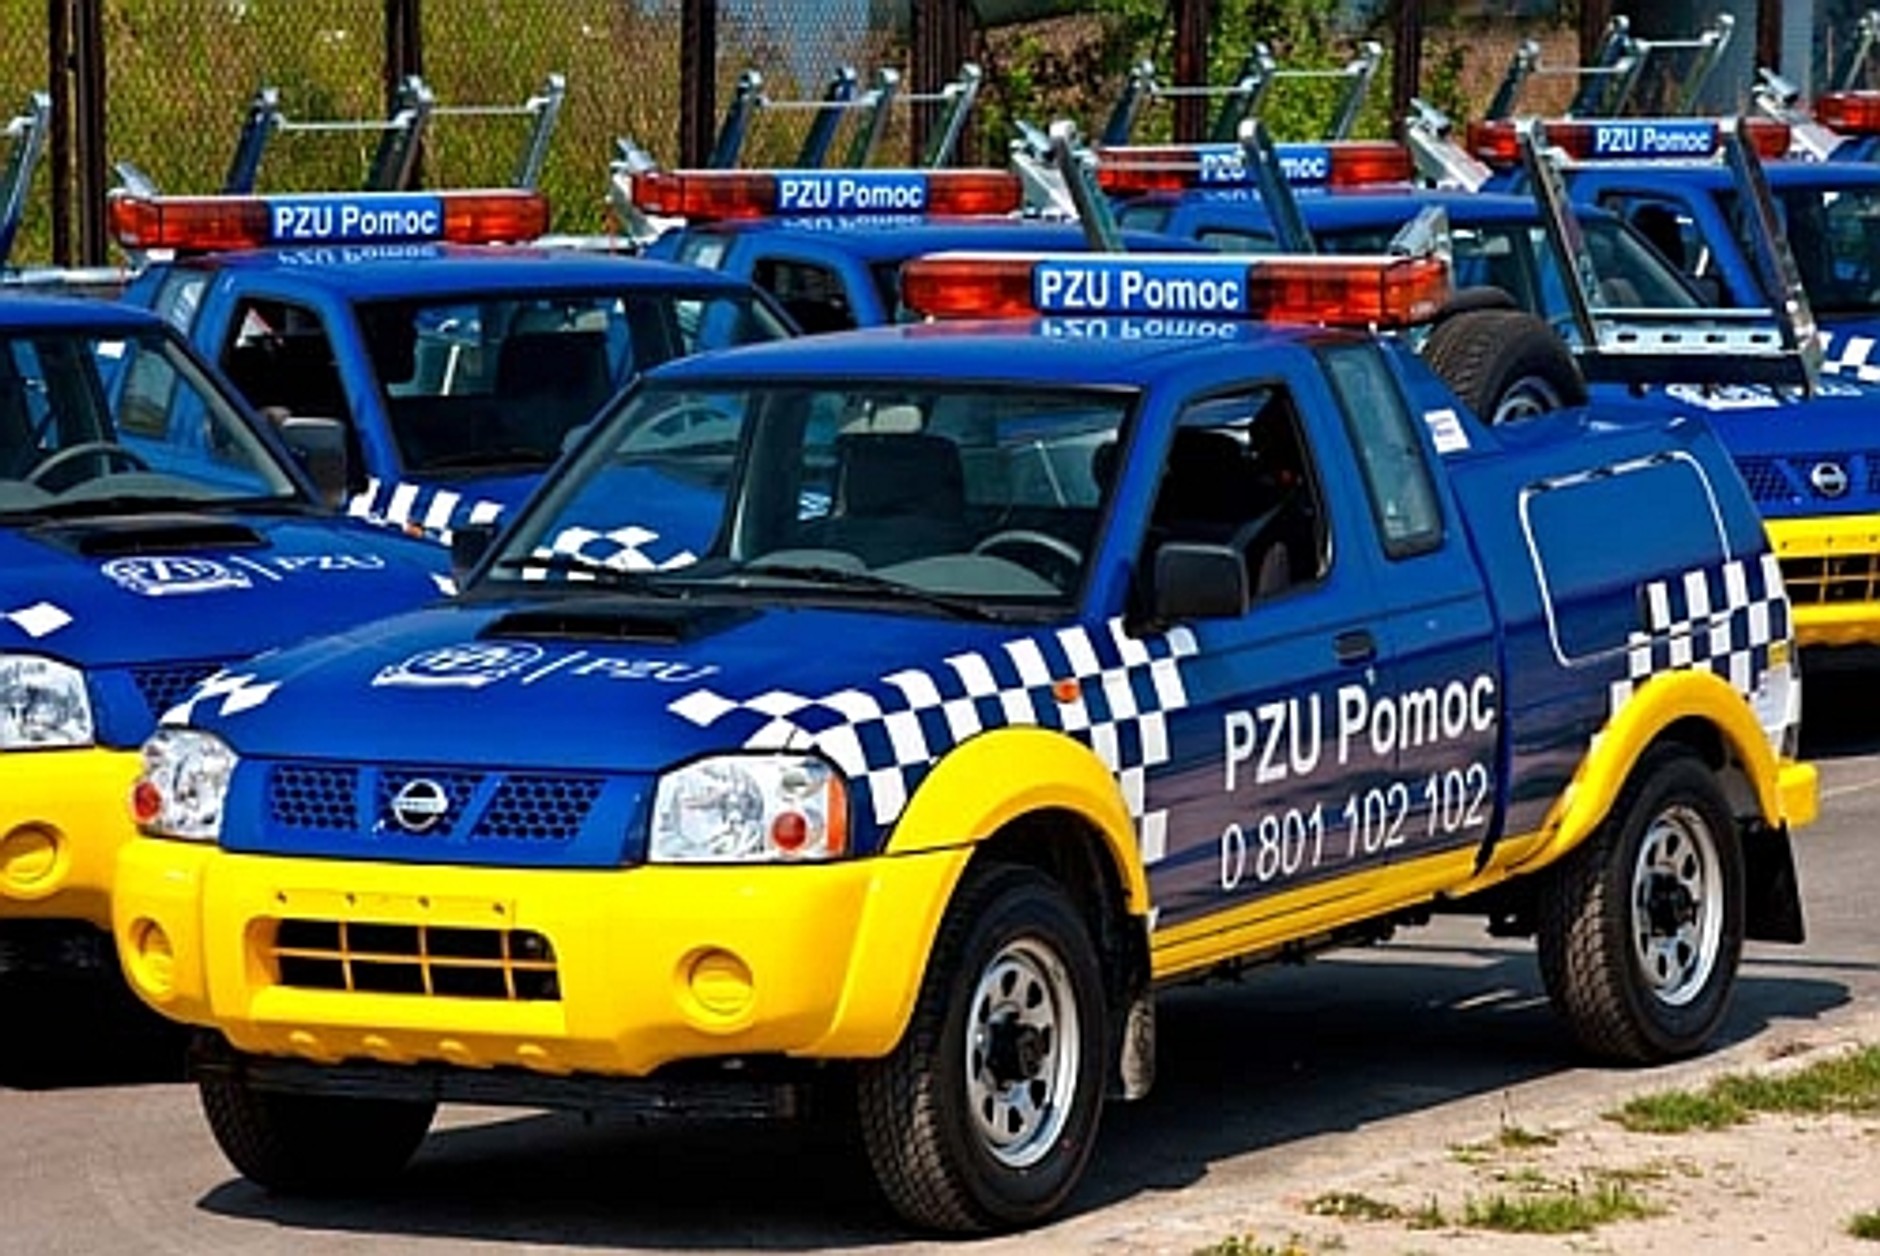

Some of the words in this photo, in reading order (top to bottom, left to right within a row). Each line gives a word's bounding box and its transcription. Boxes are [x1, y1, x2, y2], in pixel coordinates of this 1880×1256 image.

[1597, 127, 1637, 152] PZU
[1643, 127, 1710, 152] Pomoc
[780, 179, 832, 208] PZU
[838, 179, 922, 208] Pomoc
[274, 206, 333, 237] PZU
[341, 205, 437, 236] Pomoc
[1040, 269, 1109, 308] PZU
[1120, 269, 1239, 309] Pomoc
[1224, 692, 1322, 792] PZU
[1337, 674, 1494, 765] Pomoc
[1220, 822, 1246, 891] 0
[1255, 801, 1325, 881] 801
[1342, 781, 1409, 859] 102
[1424, 762, 1488, 837] 102
